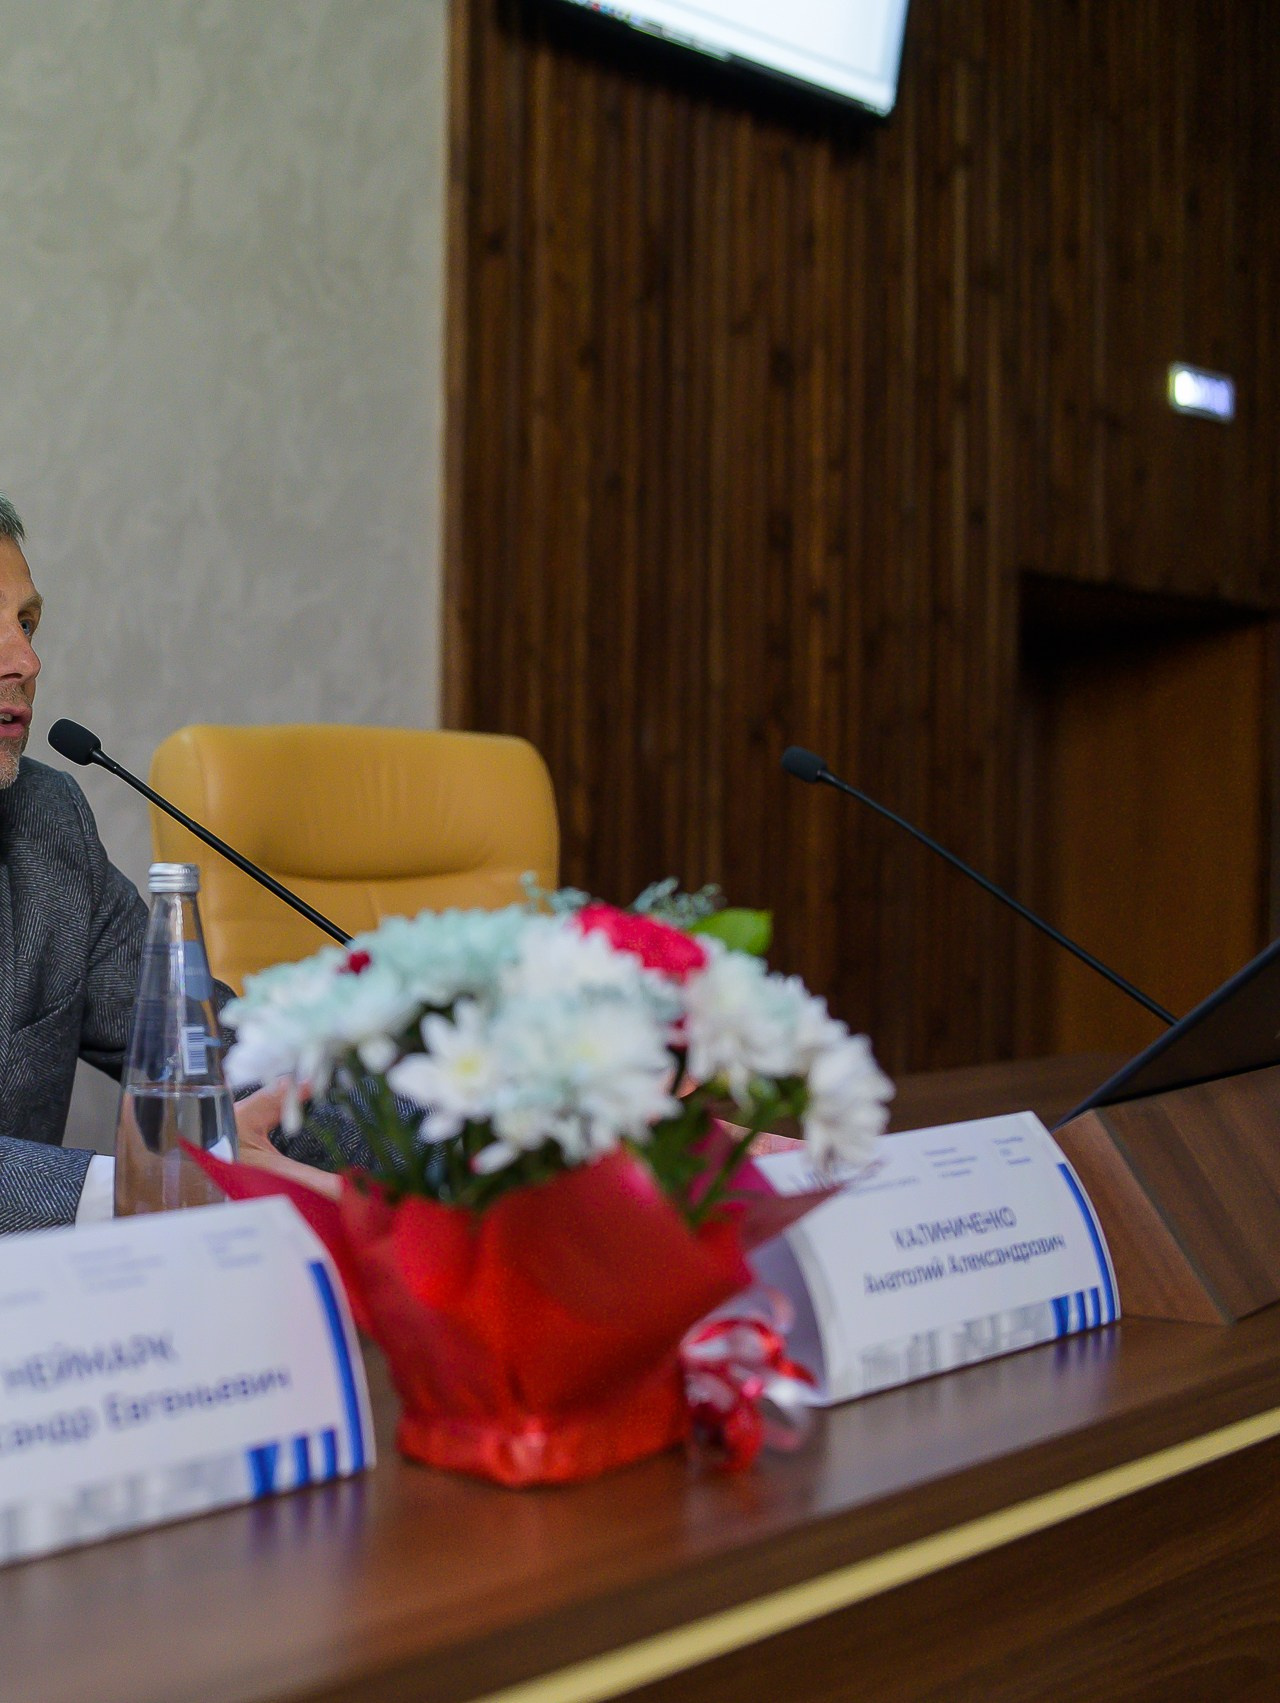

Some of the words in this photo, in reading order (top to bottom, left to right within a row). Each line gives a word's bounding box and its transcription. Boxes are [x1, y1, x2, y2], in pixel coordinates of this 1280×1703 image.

[891, 1206, 1017, 1249] КАЛИНИЧЕНКО
[864, 1256, 944, 1297] Анатолий
[947, 1234, 1065, 1277] Александрович
[0, 1332, 177, 1394] НЕЙМАРК
[104, 1366, 291, 1431] Евгеньевич
